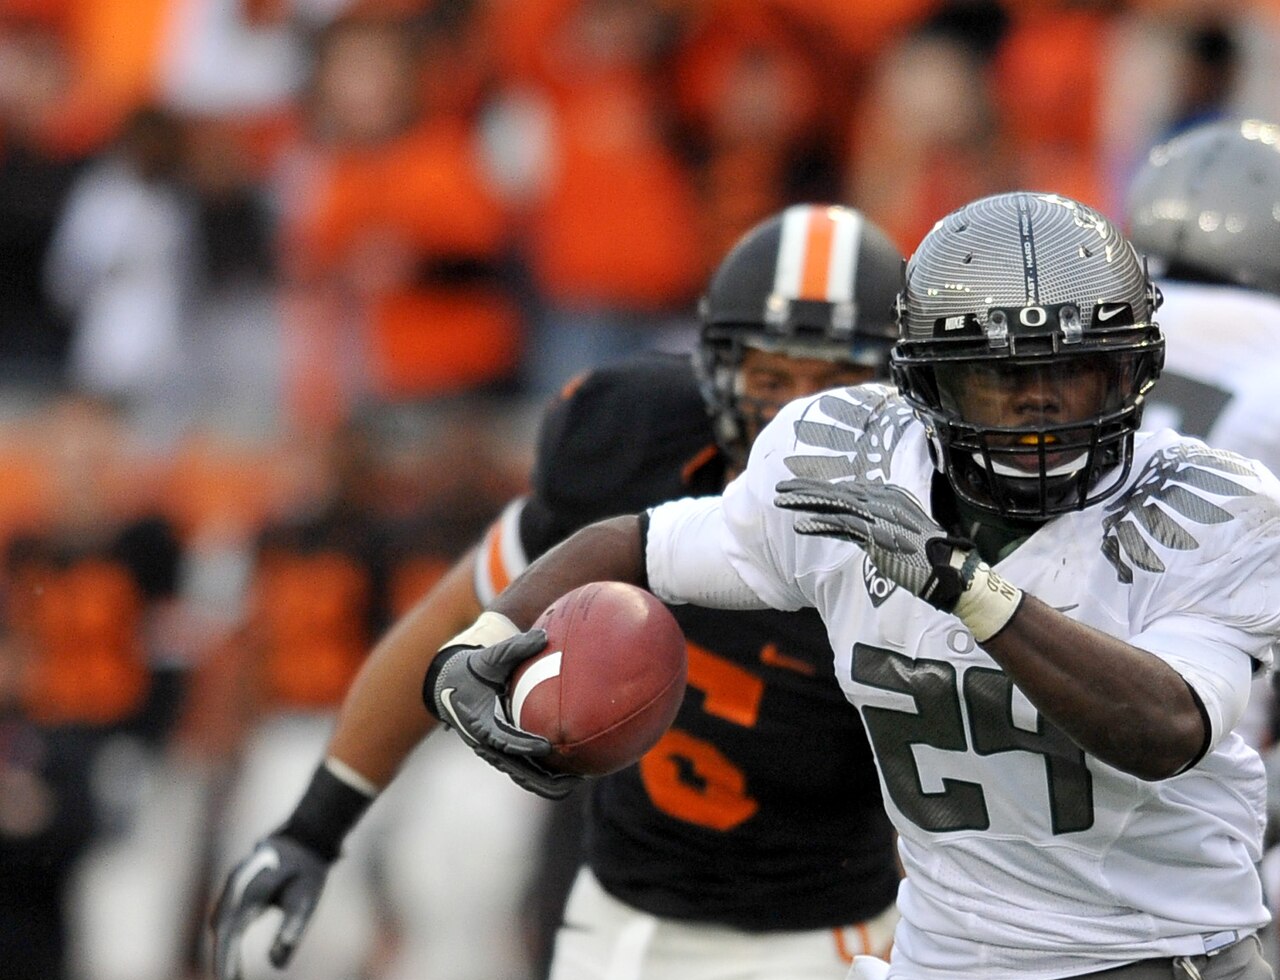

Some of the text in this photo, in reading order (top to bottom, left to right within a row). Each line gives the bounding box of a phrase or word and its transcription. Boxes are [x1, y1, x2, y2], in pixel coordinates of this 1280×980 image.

[945, 316, 965, 331] NIKE
[1020, 307, 1047, 327] O
[947, 629, 975, 654] O
[640, 638, 766, 832] 6
[851, 641, 1094, 836] 24
